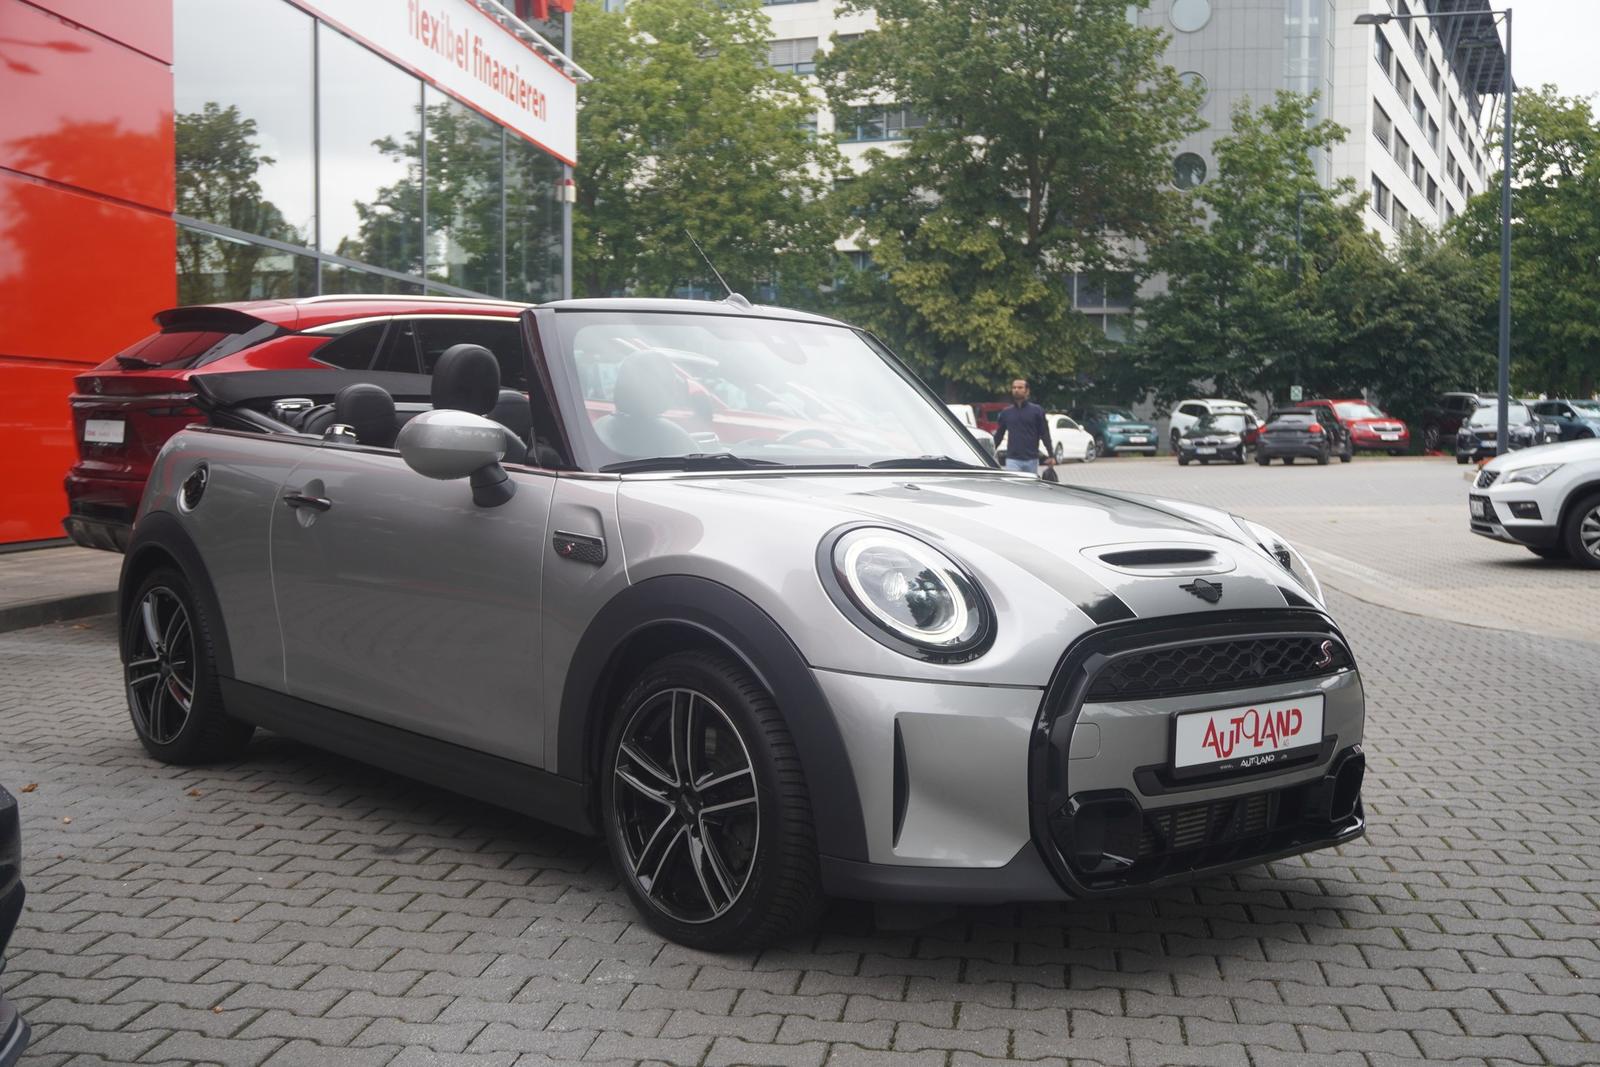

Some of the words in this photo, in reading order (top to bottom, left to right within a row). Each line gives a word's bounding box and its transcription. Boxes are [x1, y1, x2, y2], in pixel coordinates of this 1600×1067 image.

[408, 0, 469, 72] flexibel
[473, 35, 546, 122] finanzieren
[1315, 640, 1333, 668] S
